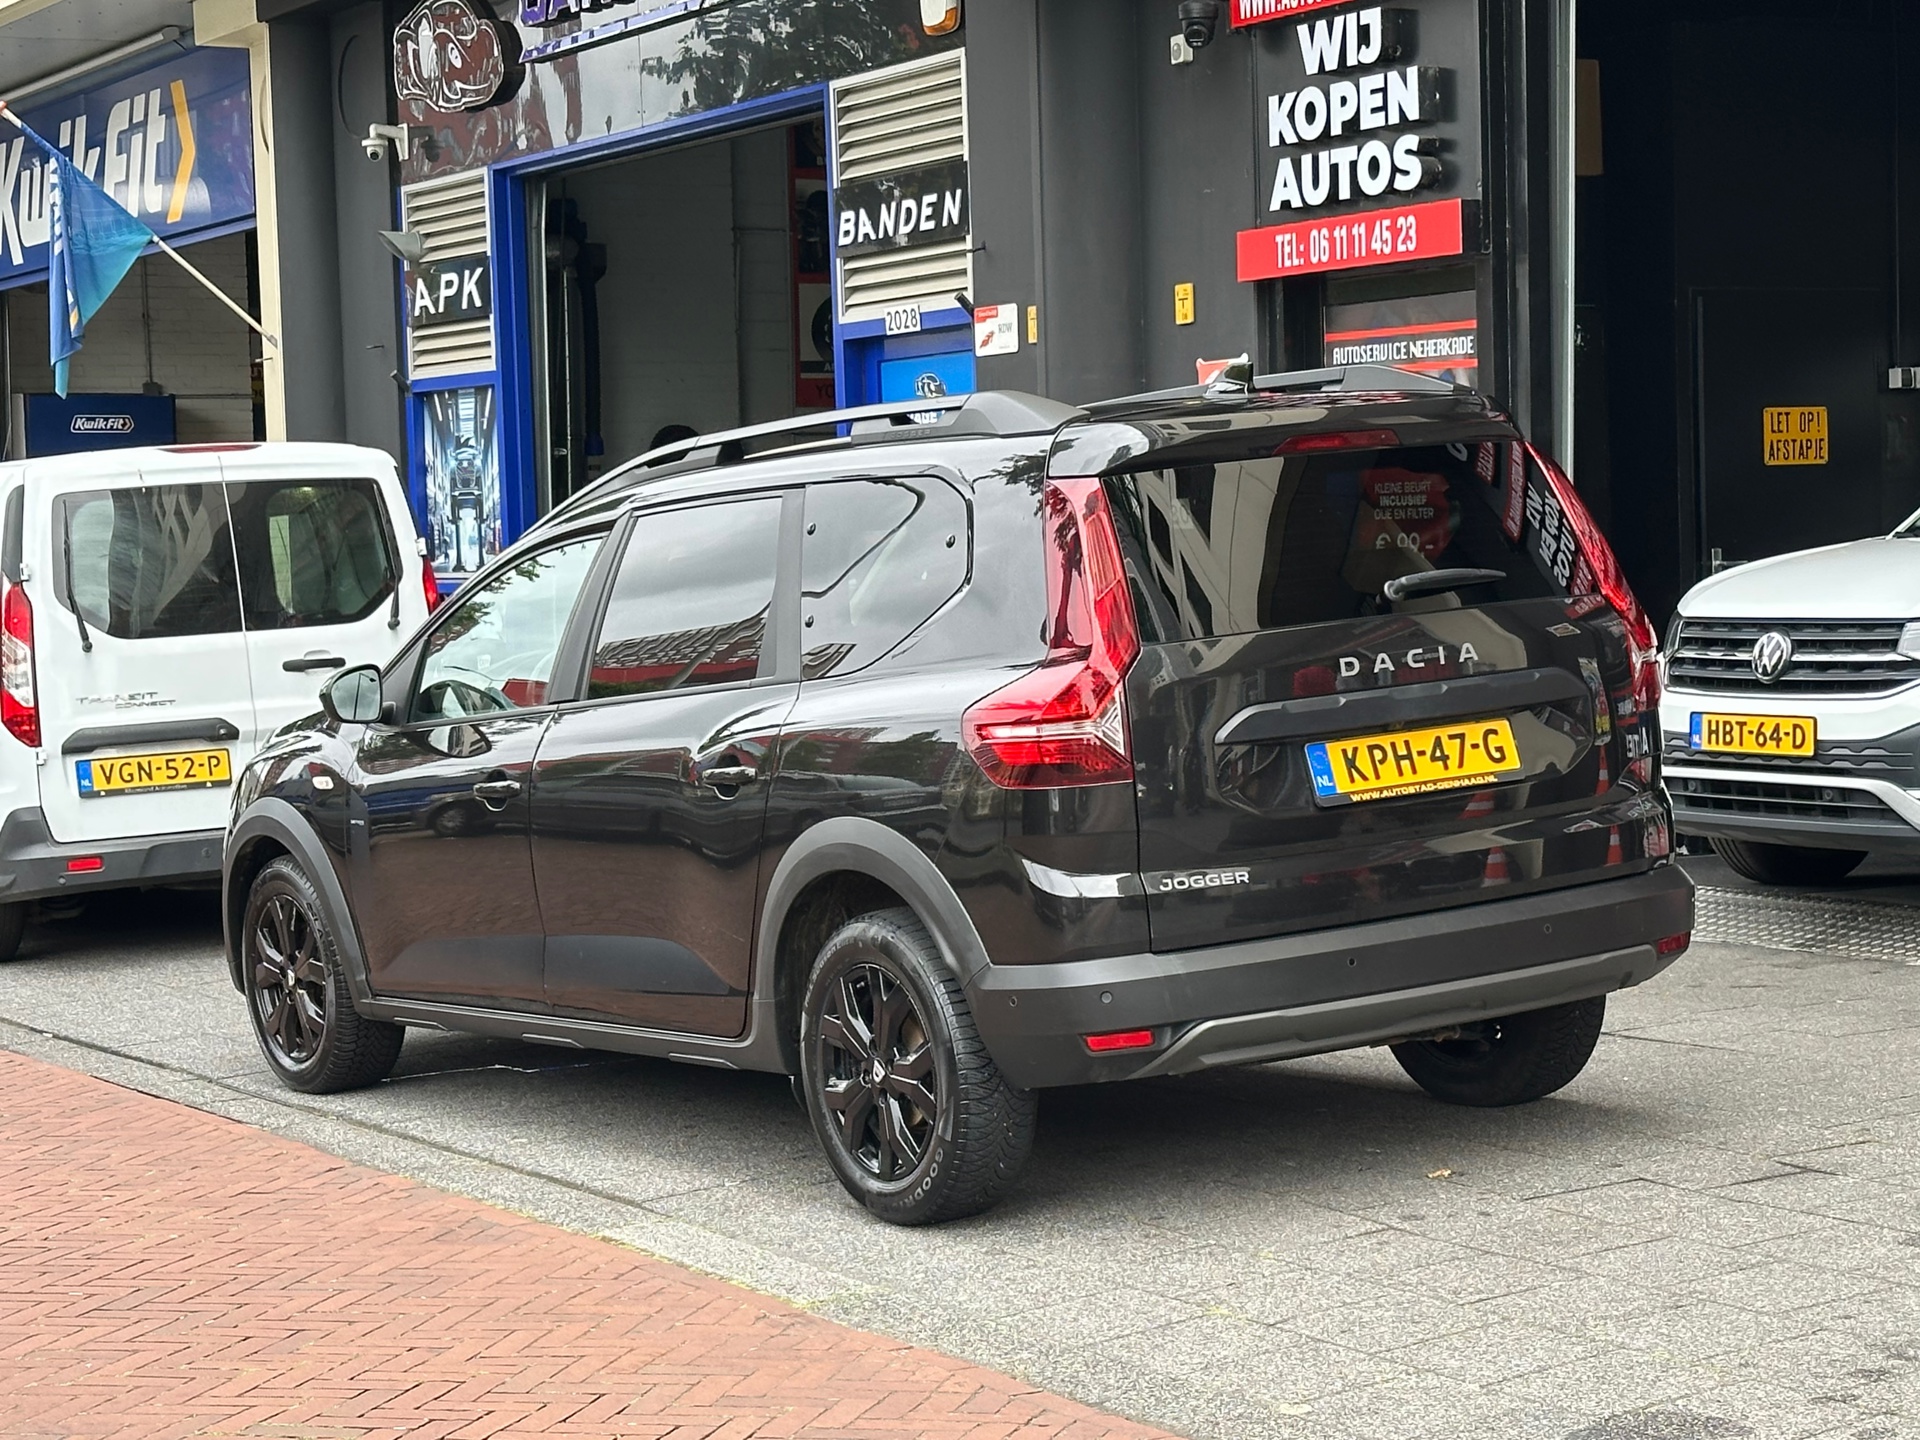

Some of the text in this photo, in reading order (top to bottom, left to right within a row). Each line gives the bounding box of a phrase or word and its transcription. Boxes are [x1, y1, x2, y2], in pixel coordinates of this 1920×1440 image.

[1296, 6, 1382, 76] WIJ
[1268, 65, 1420, 147] KOPEN
[1268, 133, 1422, 212] AUTOS
[0, 115, 101, 267] Kwk
[838, 188, 962, 247] BANDEN
[1275, 214, 1416, 268] TEL: 06 11 11 45 23
[414, 267, 484, 317] APK
[886, 309, 918, 332] 2028
[1333, 336, 1474, 365] AUTOSERVICE NEHERKADE
[1770, 411, 1820, 433] LET OP!
[1769, 438, 1825, 461] AFSTAPJE
[1374, 481, 1431, 494] KLEINE BEURT
[1380, 495, 1427, 506] INCLUSIEF
[1394, 508, 1405, 519] EN
[1407, 507, 1434, 519] FILTER
[1339, 642, 1479, 677] DACIA
[115, 700, 176, 709] CONNECT
[1707, 719, 1806, 749] HBT-64-D
[81, 755, 221, 787] NL VGN-52-P
[1318, 728, 1507, 787] NL KPH-47-G
[1159, 872, 1249, 891] JOGGER
